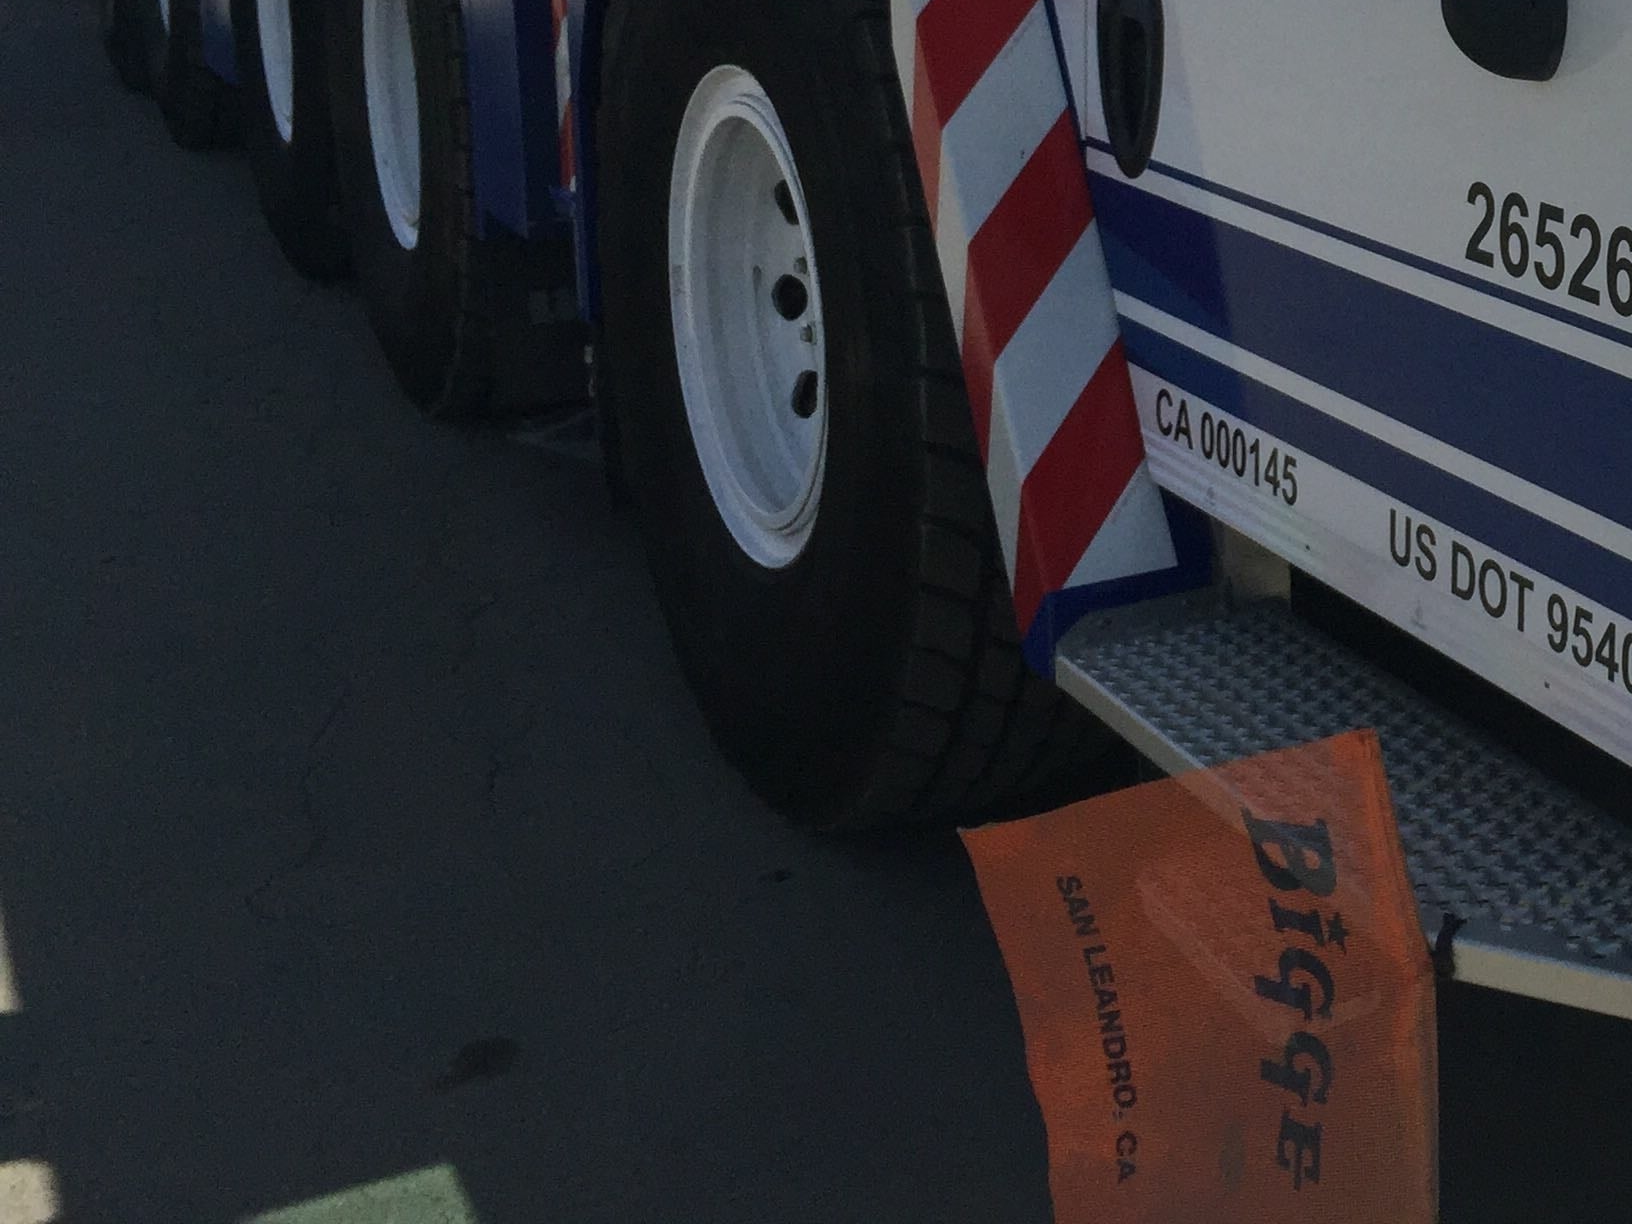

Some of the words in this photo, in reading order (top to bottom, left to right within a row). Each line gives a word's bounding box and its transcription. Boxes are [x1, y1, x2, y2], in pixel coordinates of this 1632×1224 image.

[1156, 388, 1193, 450] CA
[1201, 411, 1298, 507] 000145
[1389, 508, 1437, 582] US
[1451, 540, 1534, 632] DOT
[1056, 875, 1100, 938] SAN
[1115, 1129, 1138, 1185] CA
